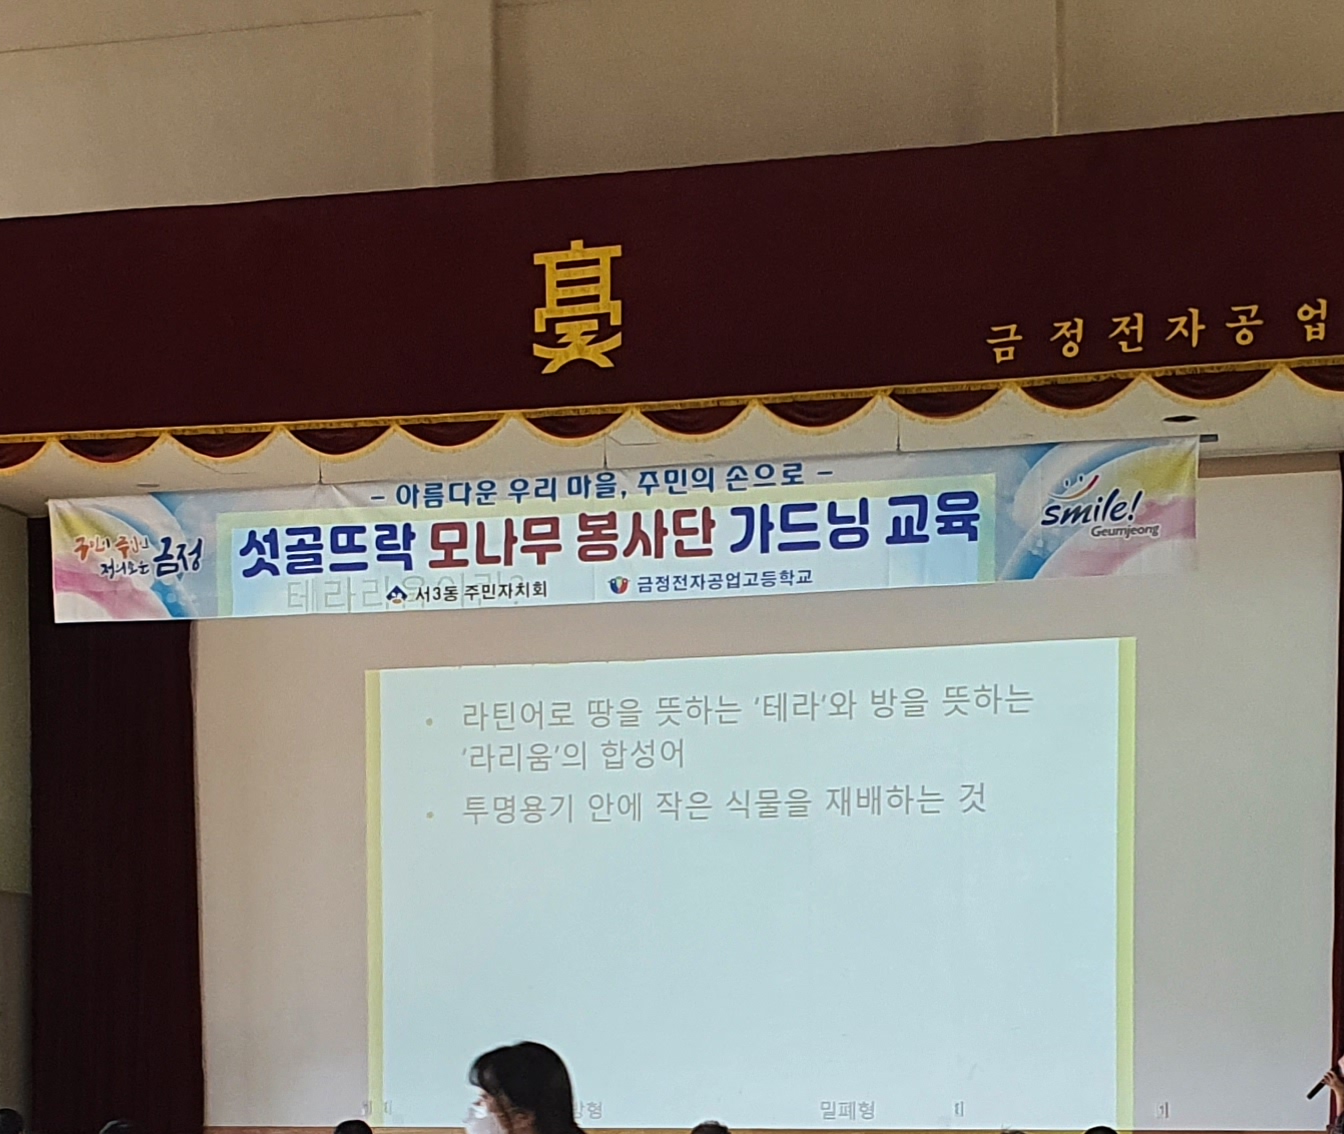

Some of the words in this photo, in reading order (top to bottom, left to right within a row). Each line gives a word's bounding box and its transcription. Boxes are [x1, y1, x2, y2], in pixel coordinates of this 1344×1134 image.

[396, 479, 498, 509] 아름다운
[508, 477, 557, 504] 우리
[567, 471, 627, 500] 마을,
[637, 466, 716, 497] 주민의
[726, 462, 804, 492] 손으로
[1041, 488, 1143, 526] smile!
[239, 522, 416, 578] 섯골뜨락
[428, 517, 563, 569] 모나무
[577, 506, 717, 562] 봉사단
[729, 497, 870, 554] 가드닝
[885, 490, 980, 545] 교육
[1090, 525, 1160, 540] Geumjeong
[153, 536, 203, 577] 금정
[415, 585, 458, 602] 서3동
[464, 580, 548, 601] 주민자치회
[637, 569, 813, 593] 금정전자공업고등학교
[463, 701, 575, 731] 라틴어로
[587, 698, 643, 728] 땅을
[656, 695, 742, 726] 뜻하는
[871, 687, 928, 718] 방을
[942, 683, 1034, 716] 뜻하는
[601, 738, 684, 770] 합성어
[463, 794, 573, 825] 투명용기
[588, 792, 642, 823] 안에
[656, 791, 712, 821] 작은
[725, 788, 812, 819] 식물을
[826, 784, 945, 816] 재배하는
[959, 782, 987, 814] 것
[820, 1100, 875, 1121] 밀폐형
